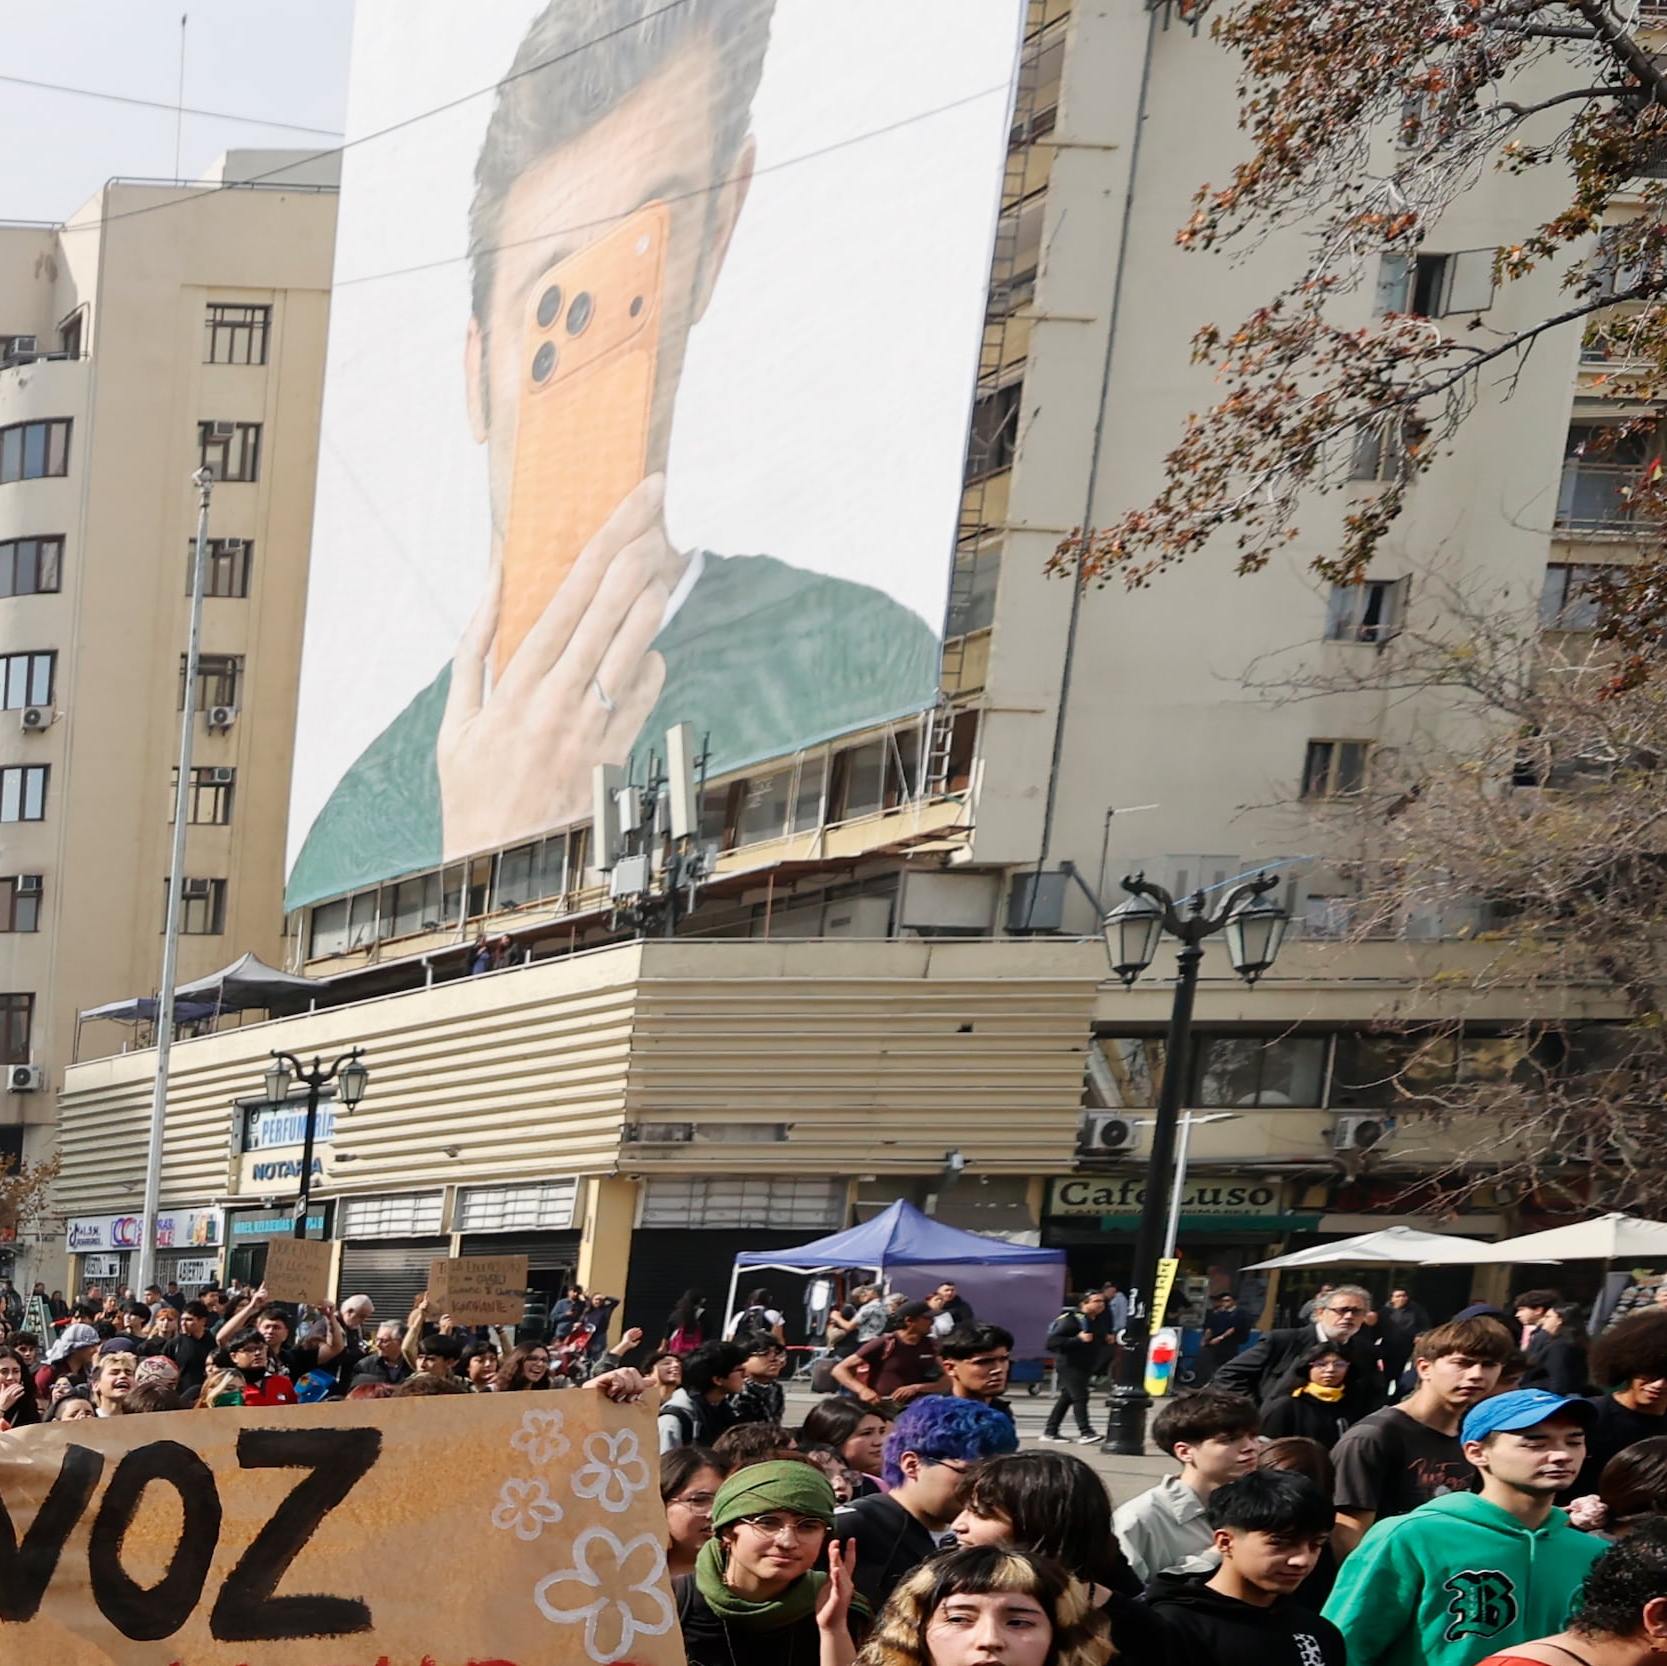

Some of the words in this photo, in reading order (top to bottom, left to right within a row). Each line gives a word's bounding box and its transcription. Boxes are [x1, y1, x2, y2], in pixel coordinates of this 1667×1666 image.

[262, 1108, 335, 1145] PERFUMRÍA
[252, 1157, 323, 1181] NOTARA
[1442, 1569, 1519, 1643] B
